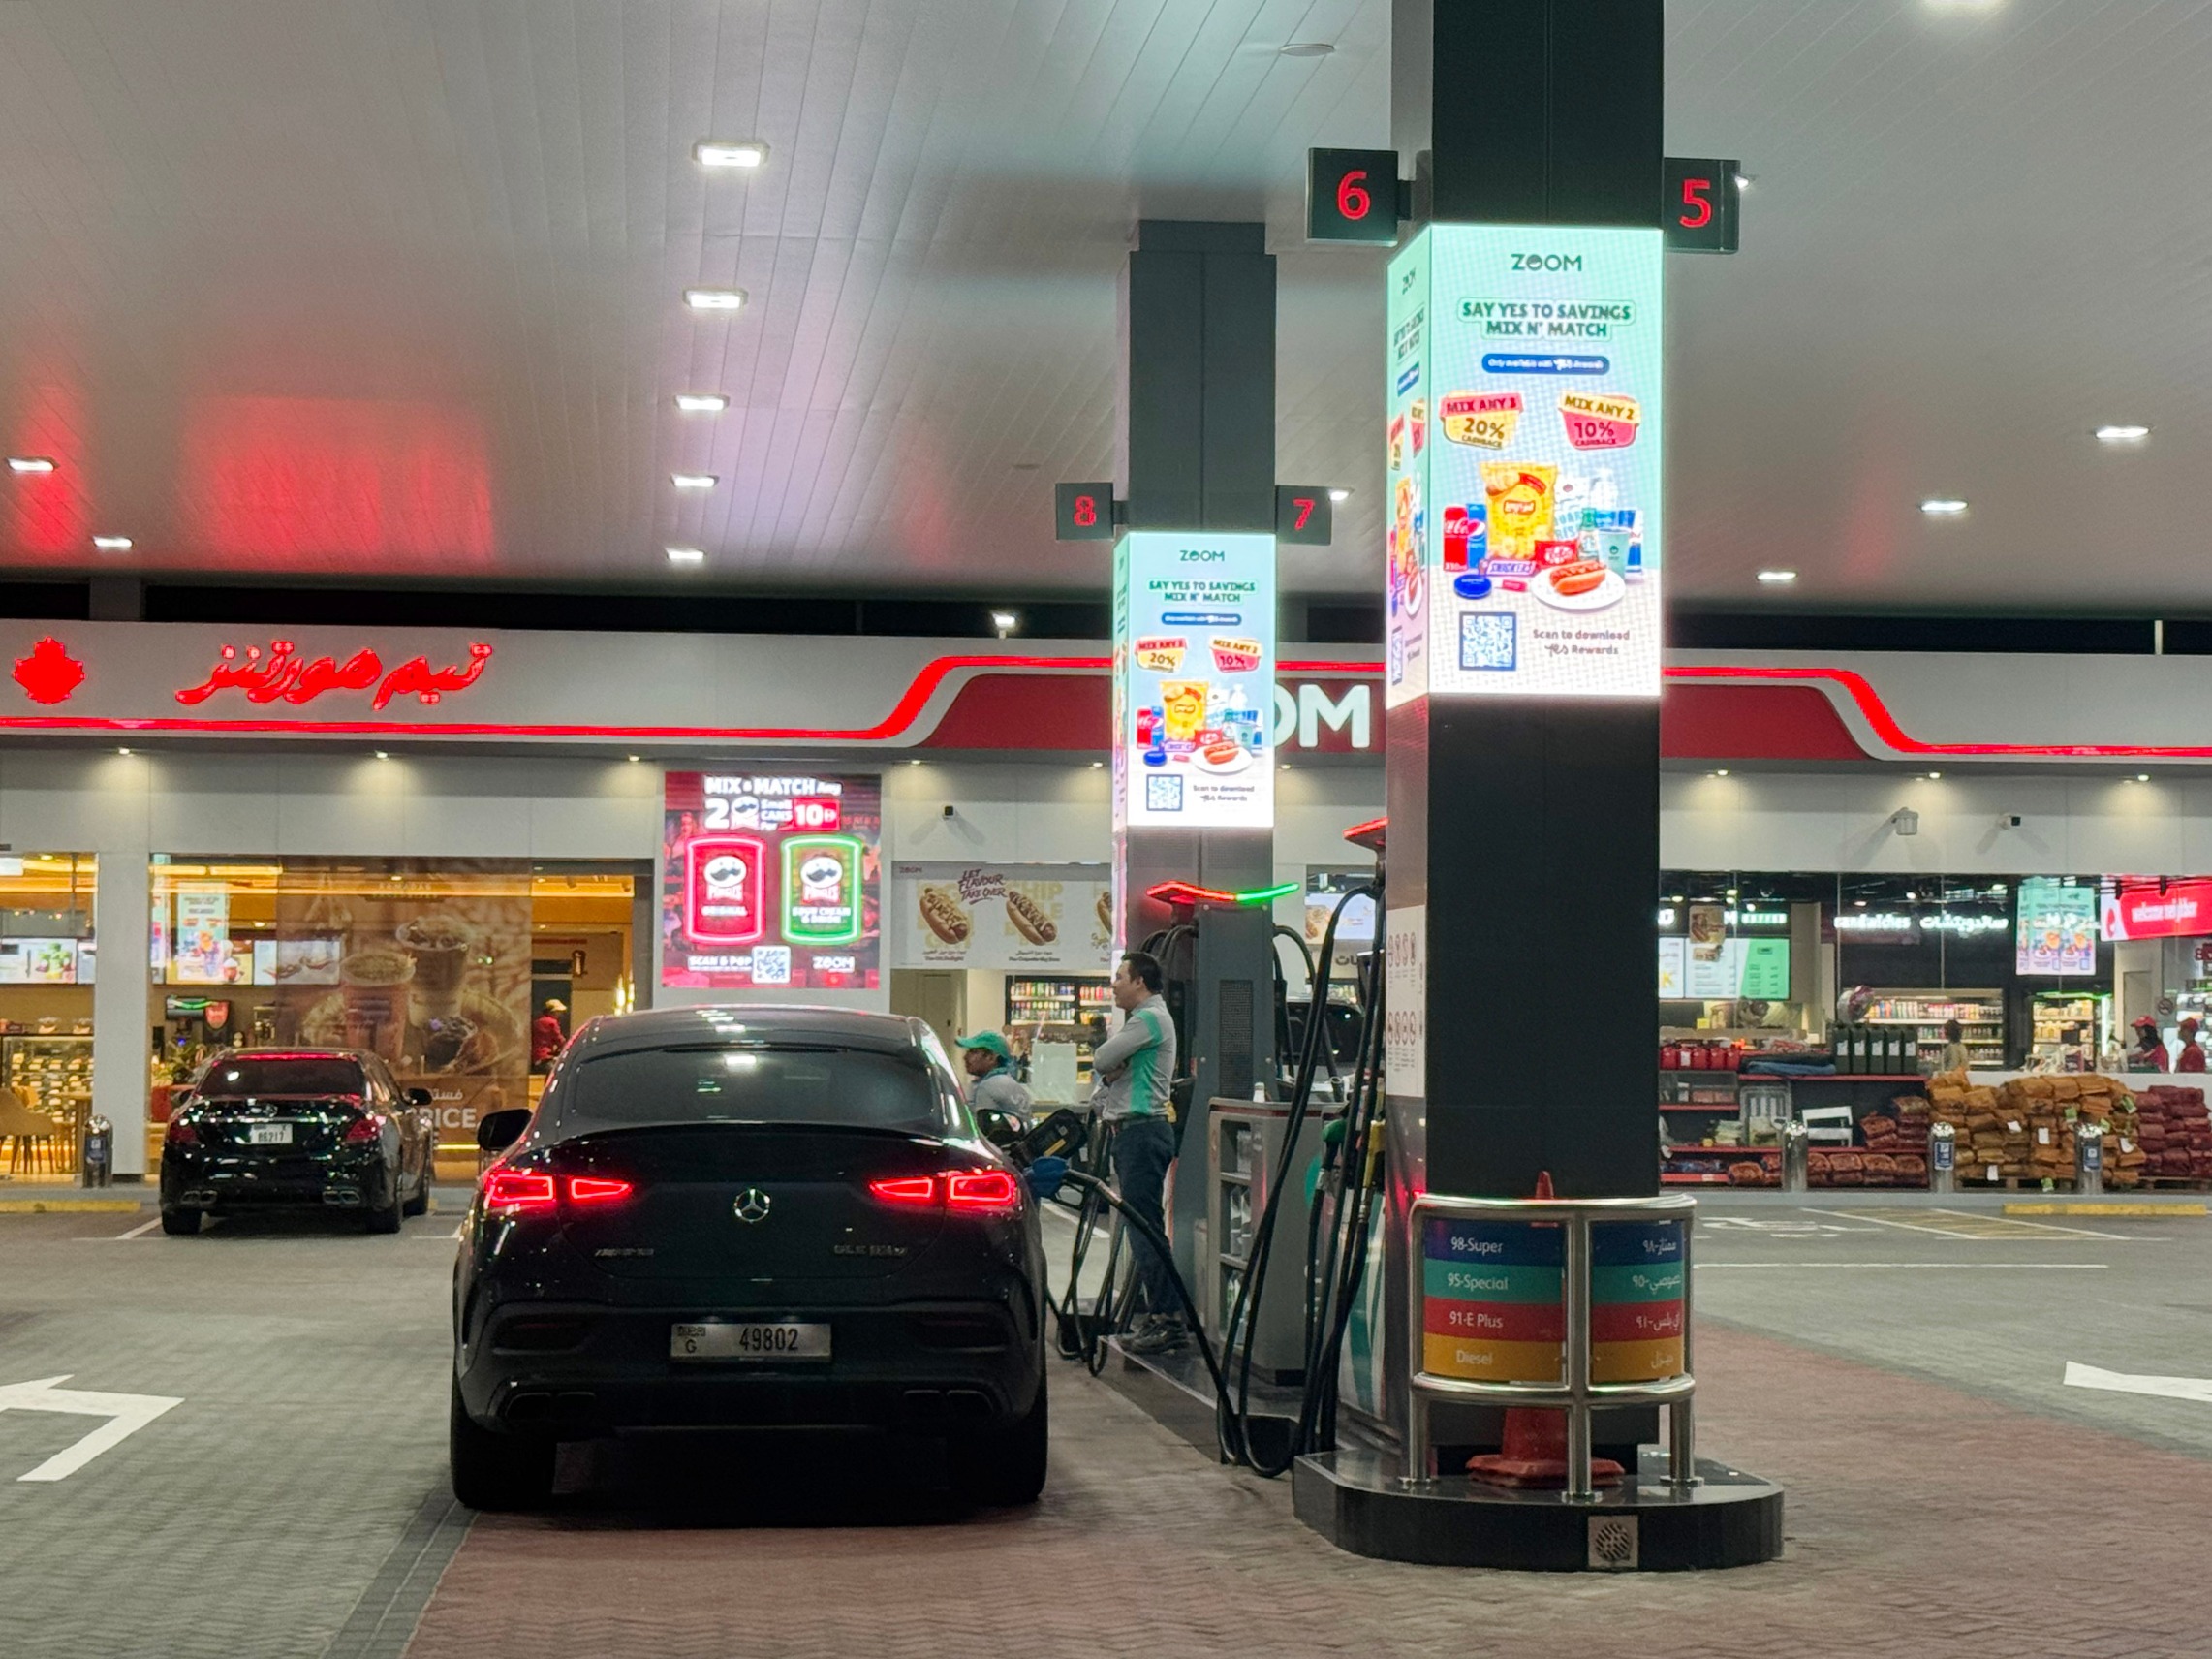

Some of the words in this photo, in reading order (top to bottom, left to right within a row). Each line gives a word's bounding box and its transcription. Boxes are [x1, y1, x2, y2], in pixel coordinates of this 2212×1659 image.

[1336, 171, 1371, 221] 6
[1679, 178, 1712, 229] 5
[1511, 253, 1582, 272] ZOOM
[1462, 301, 1493, 318] SAY
[1498, 302, 1528, 318] YES
[1533, 303, 1553, 319] TO
[1557, 303, 1631, 320] SAVINGS
[1486, 321, 1525, 336] MIX
[1547, 321, 1607, 337] MATCH
[1447, 400, 1475, 413] MIX
[1479, 398, 1506, 411] ANY
[1565, 395, 1593, 412] MIX
[1596, 402, 1625, 417] ANY
[1626, 408, 1635, 420] 2
[1463, 417, 1505, 440] 20%
[1574, 422, 1614, 439] 10%
[1073, 495, 1097, 527] 8
[1293, 498, 1316, 530] 7
[1179, 549, 1226, 562] ZOOM
[1149, 581, 1169, 590] SAY
[1171, 581, 1190, 590] YES
[1193, 581, 1206, 590] TO
[1209, 581, 1255, 591] SAVINGS
[1164, 593, 1187, 602] MIX
[1202, 593, 1241, 602] MATCH
[1533, 629, 1559, 640] Scan
[1561, 630, 1573, 640] to
[1574, 629, 1630, 641] download
[1572, 644, 1619, 656] Rewards
[1150, 652, 1176, 667] 20%
[1220, 655, 1245, 666] 10%
[704, 776, 742, 795] MIX
[753, 777, 817, 795] MATCH
[705, 797, 730, 829] 2
[794, 804, 824, 826] 10
[958, 873, 1006, 892] FLAVOUR
[962, 868, 982, 879] LET
[960, 888, 982, 902] TAKE
[982, 887, 1009, 898] OVER
[688, 955, 717, 966] SCAN
[813, 956, 856, 970] ZOOM
[1450, 1236, 1504, 1257] 98-Super
[1447, 1272, 1509, 1292] 95-Special
[1449, 1310, 1474, 1327] 91-E
[1477, 1313, 1504, 1329] Plus
[685, 1338, 698, 1354] G
[739, 1327, 799, 1351] 49802
[1455, 1349, 1493, 1365] Diesel
